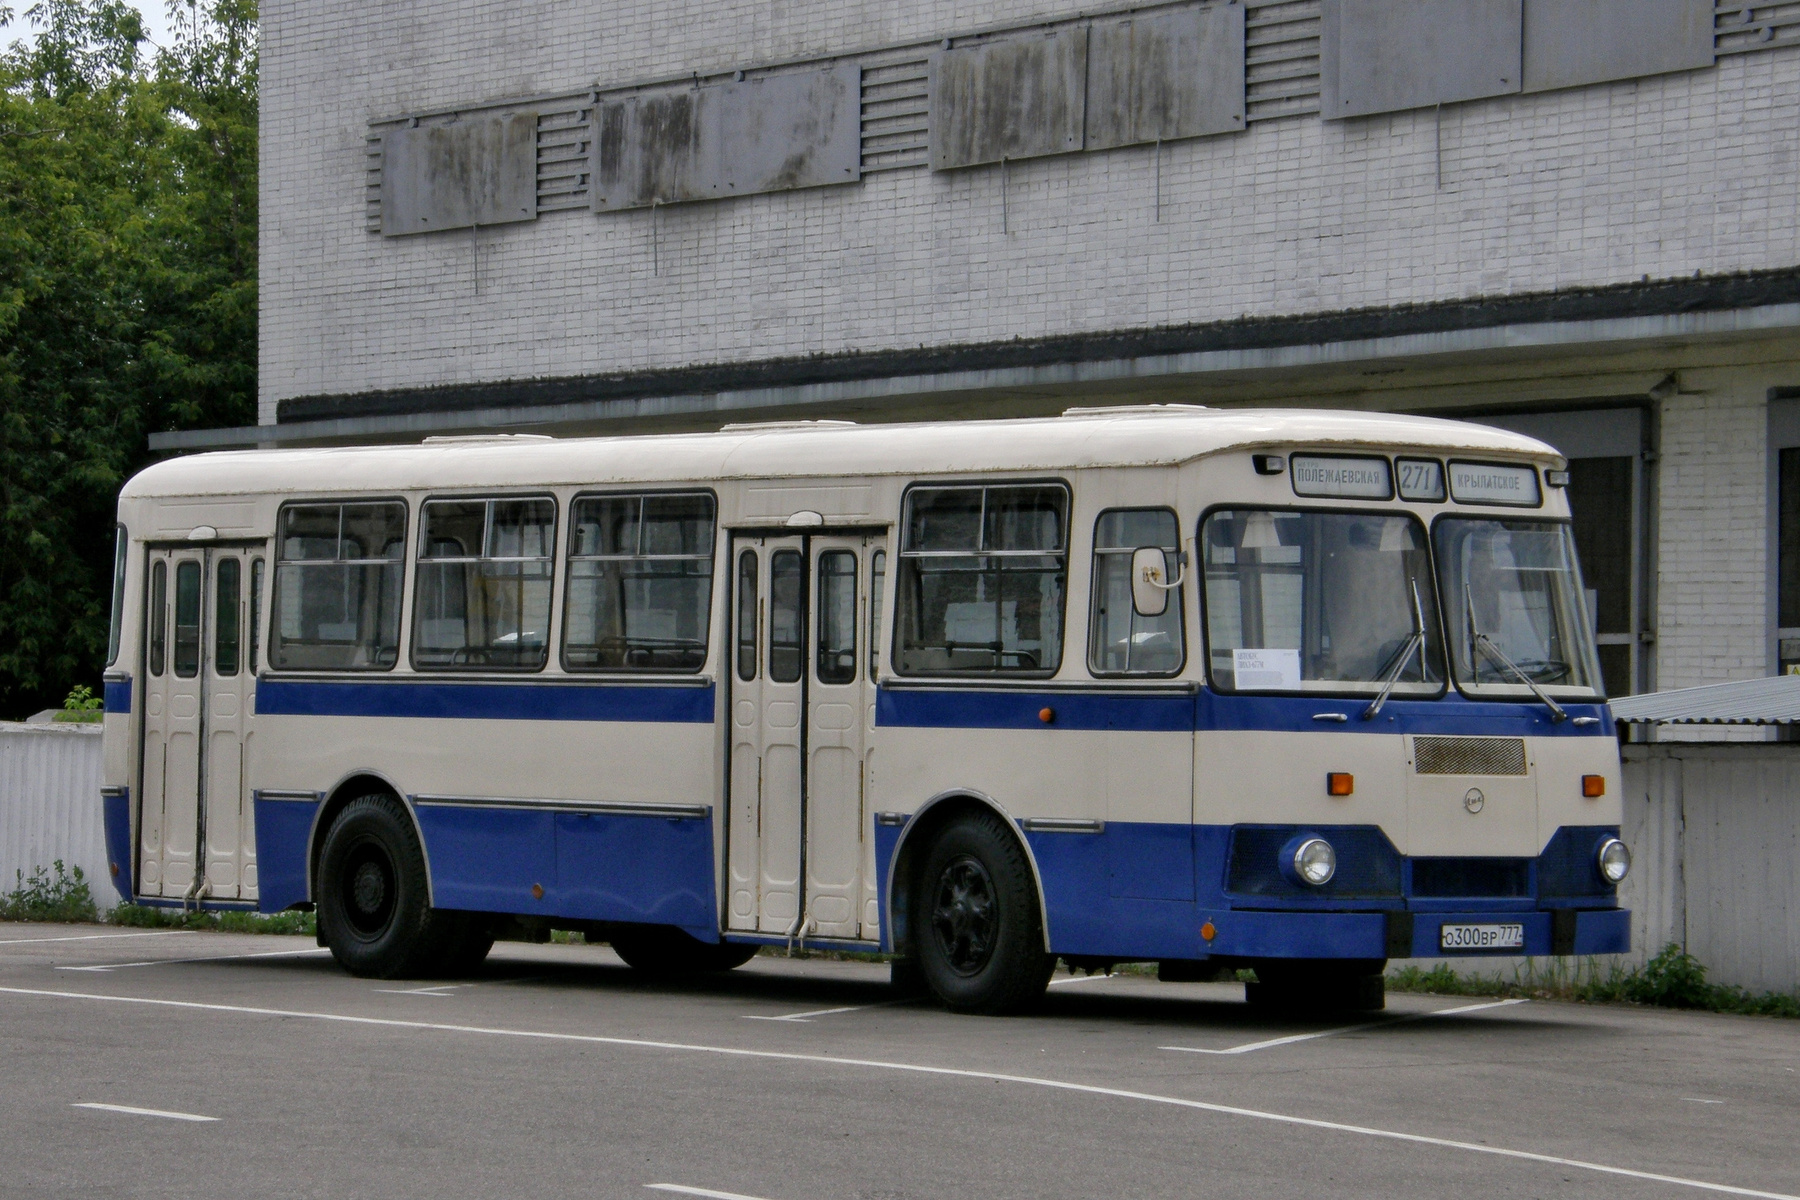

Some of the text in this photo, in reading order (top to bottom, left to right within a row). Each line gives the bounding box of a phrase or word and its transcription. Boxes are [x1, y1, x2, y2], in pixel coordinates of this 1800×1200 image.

[1298, 468, 1380, 484] ПОЛЕЖАЕВСКАЯ
[1401, 465, 1430, 490] 271
[1457, 474, 1520, 490] КРЫЛАТСКОЕ
[1500, 926, 1520, 940] 777
